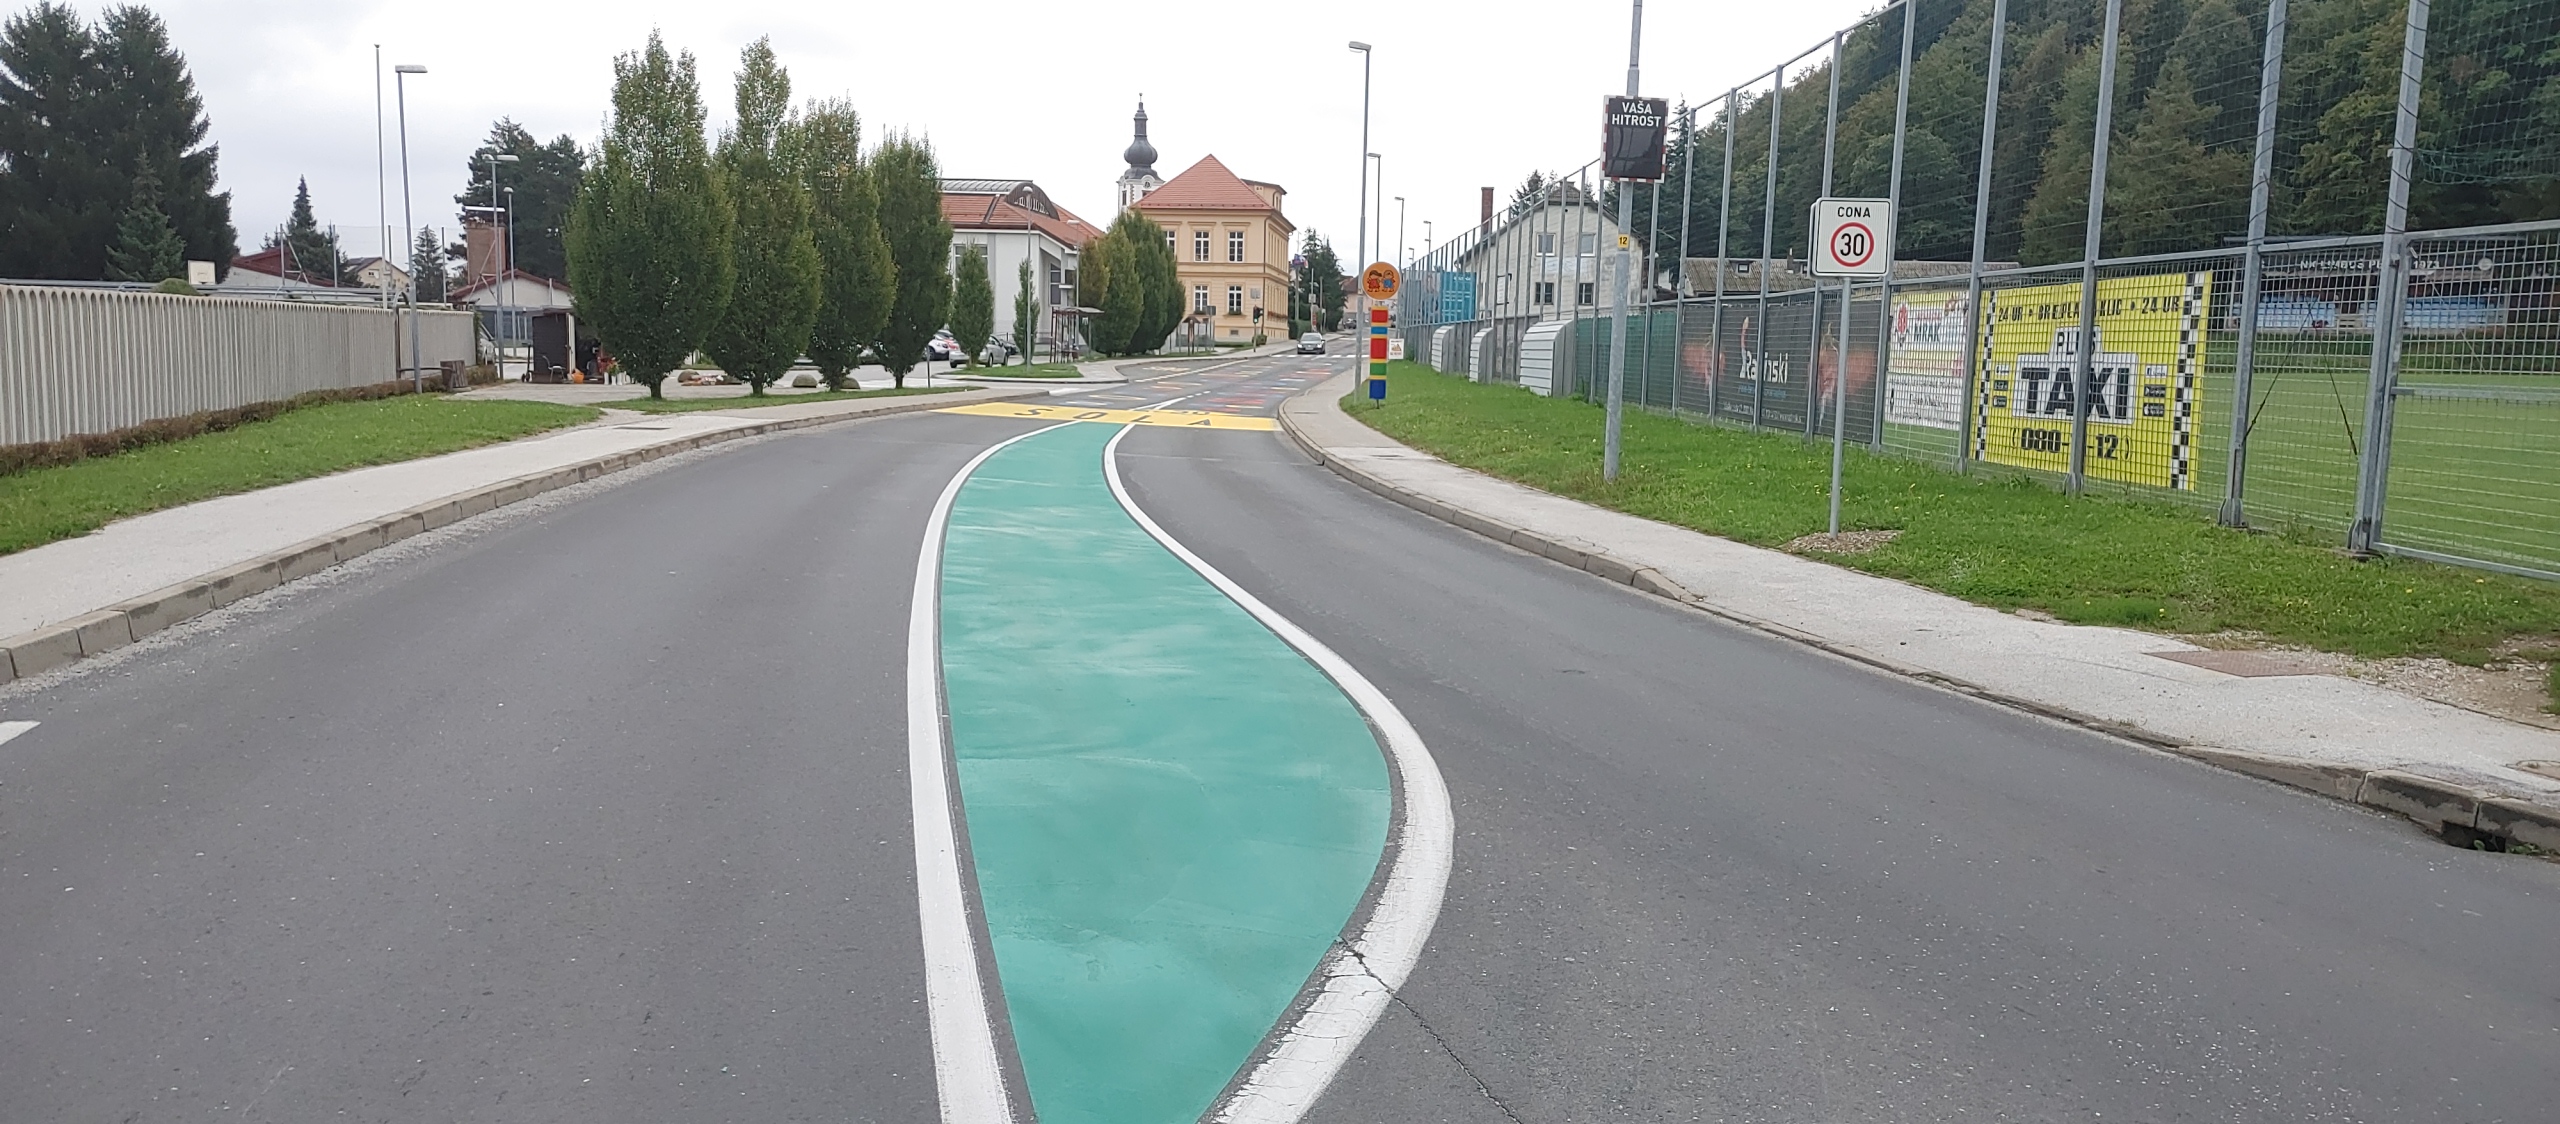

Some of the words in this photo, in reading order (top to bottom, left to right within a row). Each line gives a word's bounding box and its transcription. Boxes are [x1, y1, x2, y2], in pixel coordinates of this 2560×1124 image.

[1622, 100, 1652, 115] VAŠA
[1611, 113, 1662, 128] HITROST
[1837, 206, 1871, 218] CONA
[1619, 236, 1628, 245] 12
[1840, 232, 1865, 257] 30
[2142, 297, 2159, 315] 24
[2021, 367, 2130, 420] TAXI
